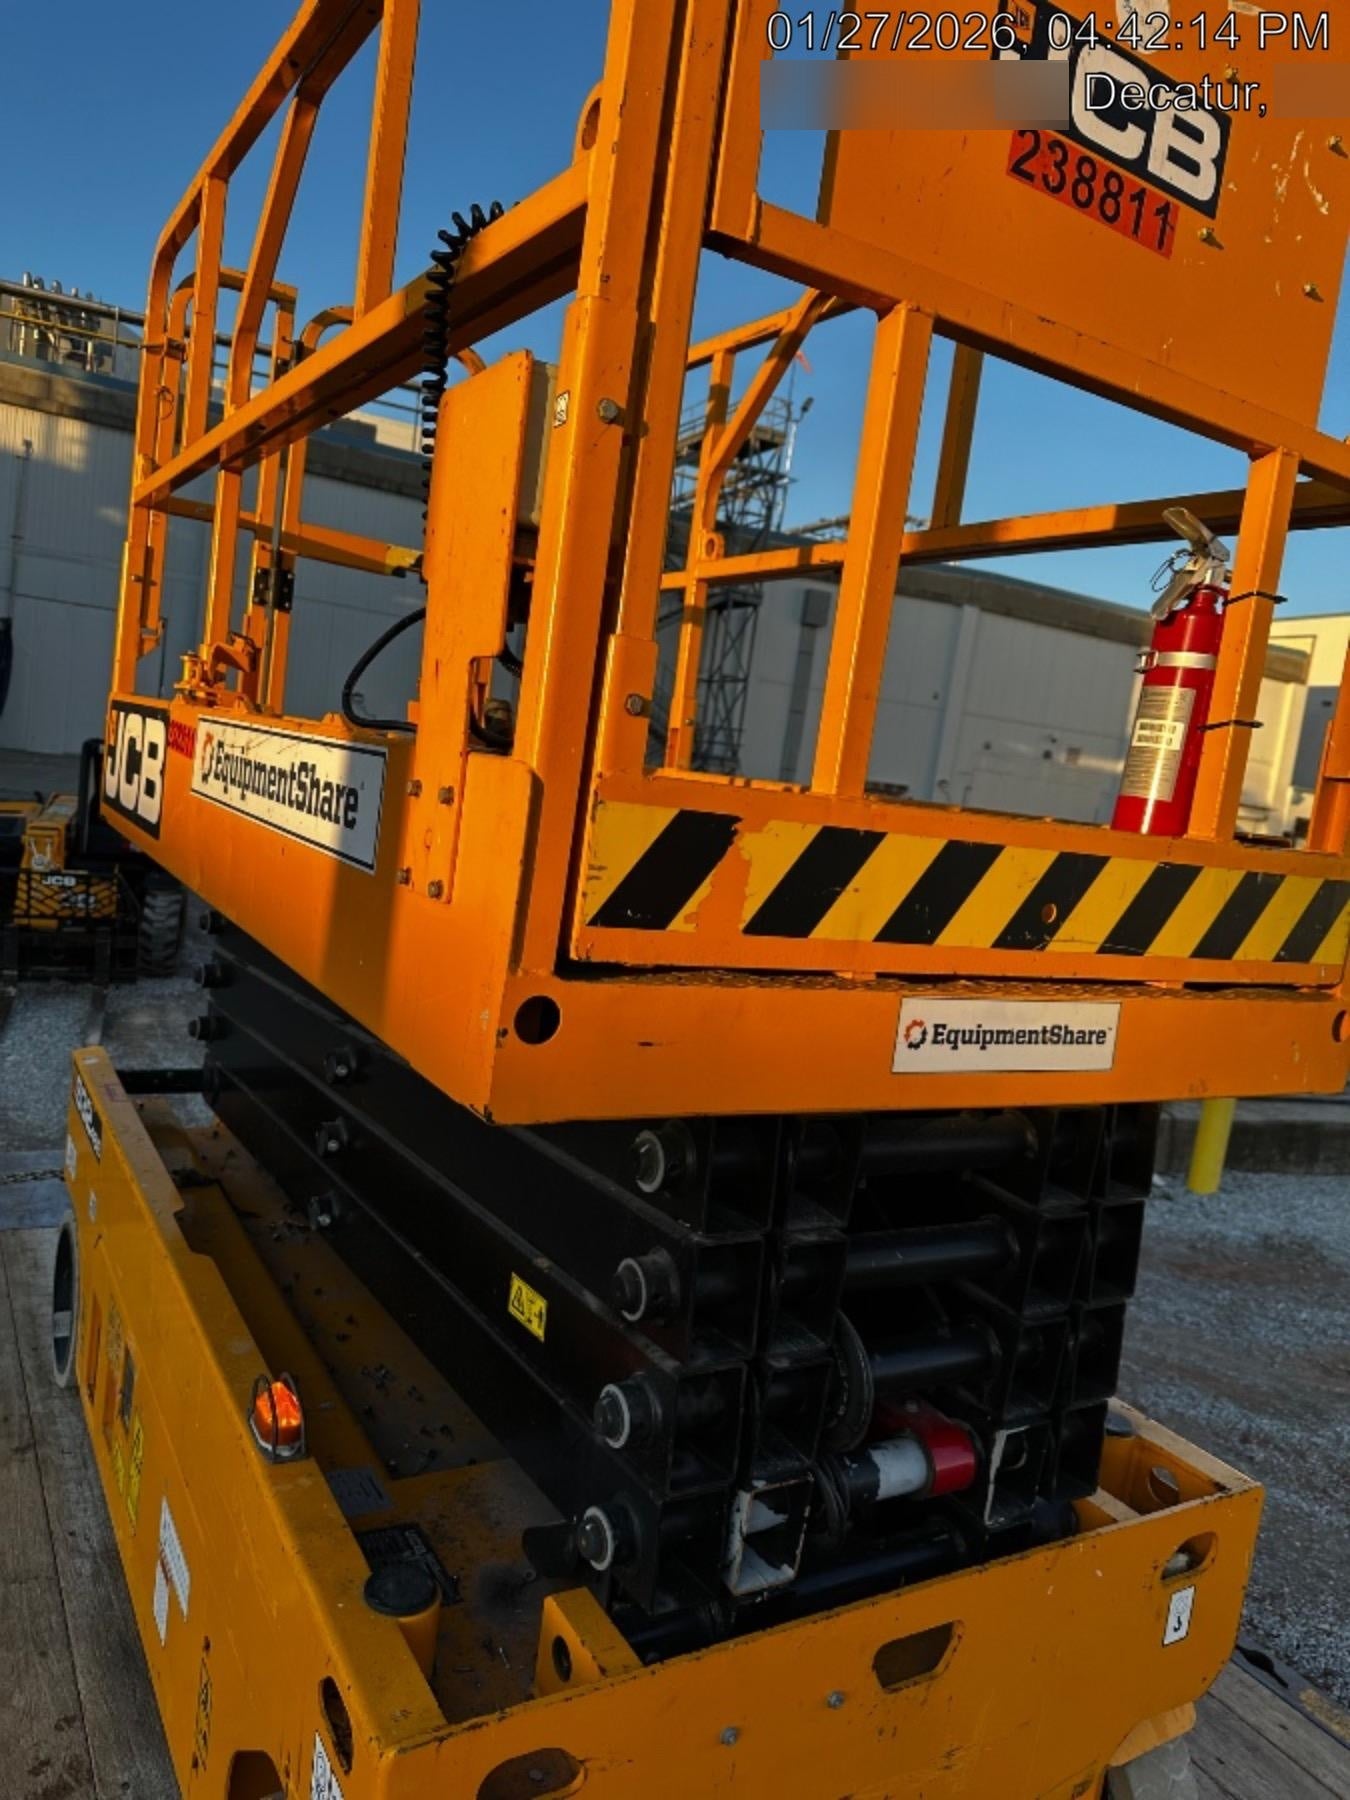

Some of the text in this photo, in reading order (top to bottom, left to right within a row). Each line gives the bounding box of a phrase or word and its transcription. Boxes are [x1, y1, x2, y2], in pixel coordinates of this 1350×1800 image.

[1010, 130, 1175, 252] 238811
[105, 709, 167, 825] JCB
[213, 739, 359, 830] EquipmentShare
[42, 875, 77, 886] JCB
[931, 1023, 1107, 1050] EquipmentShare
